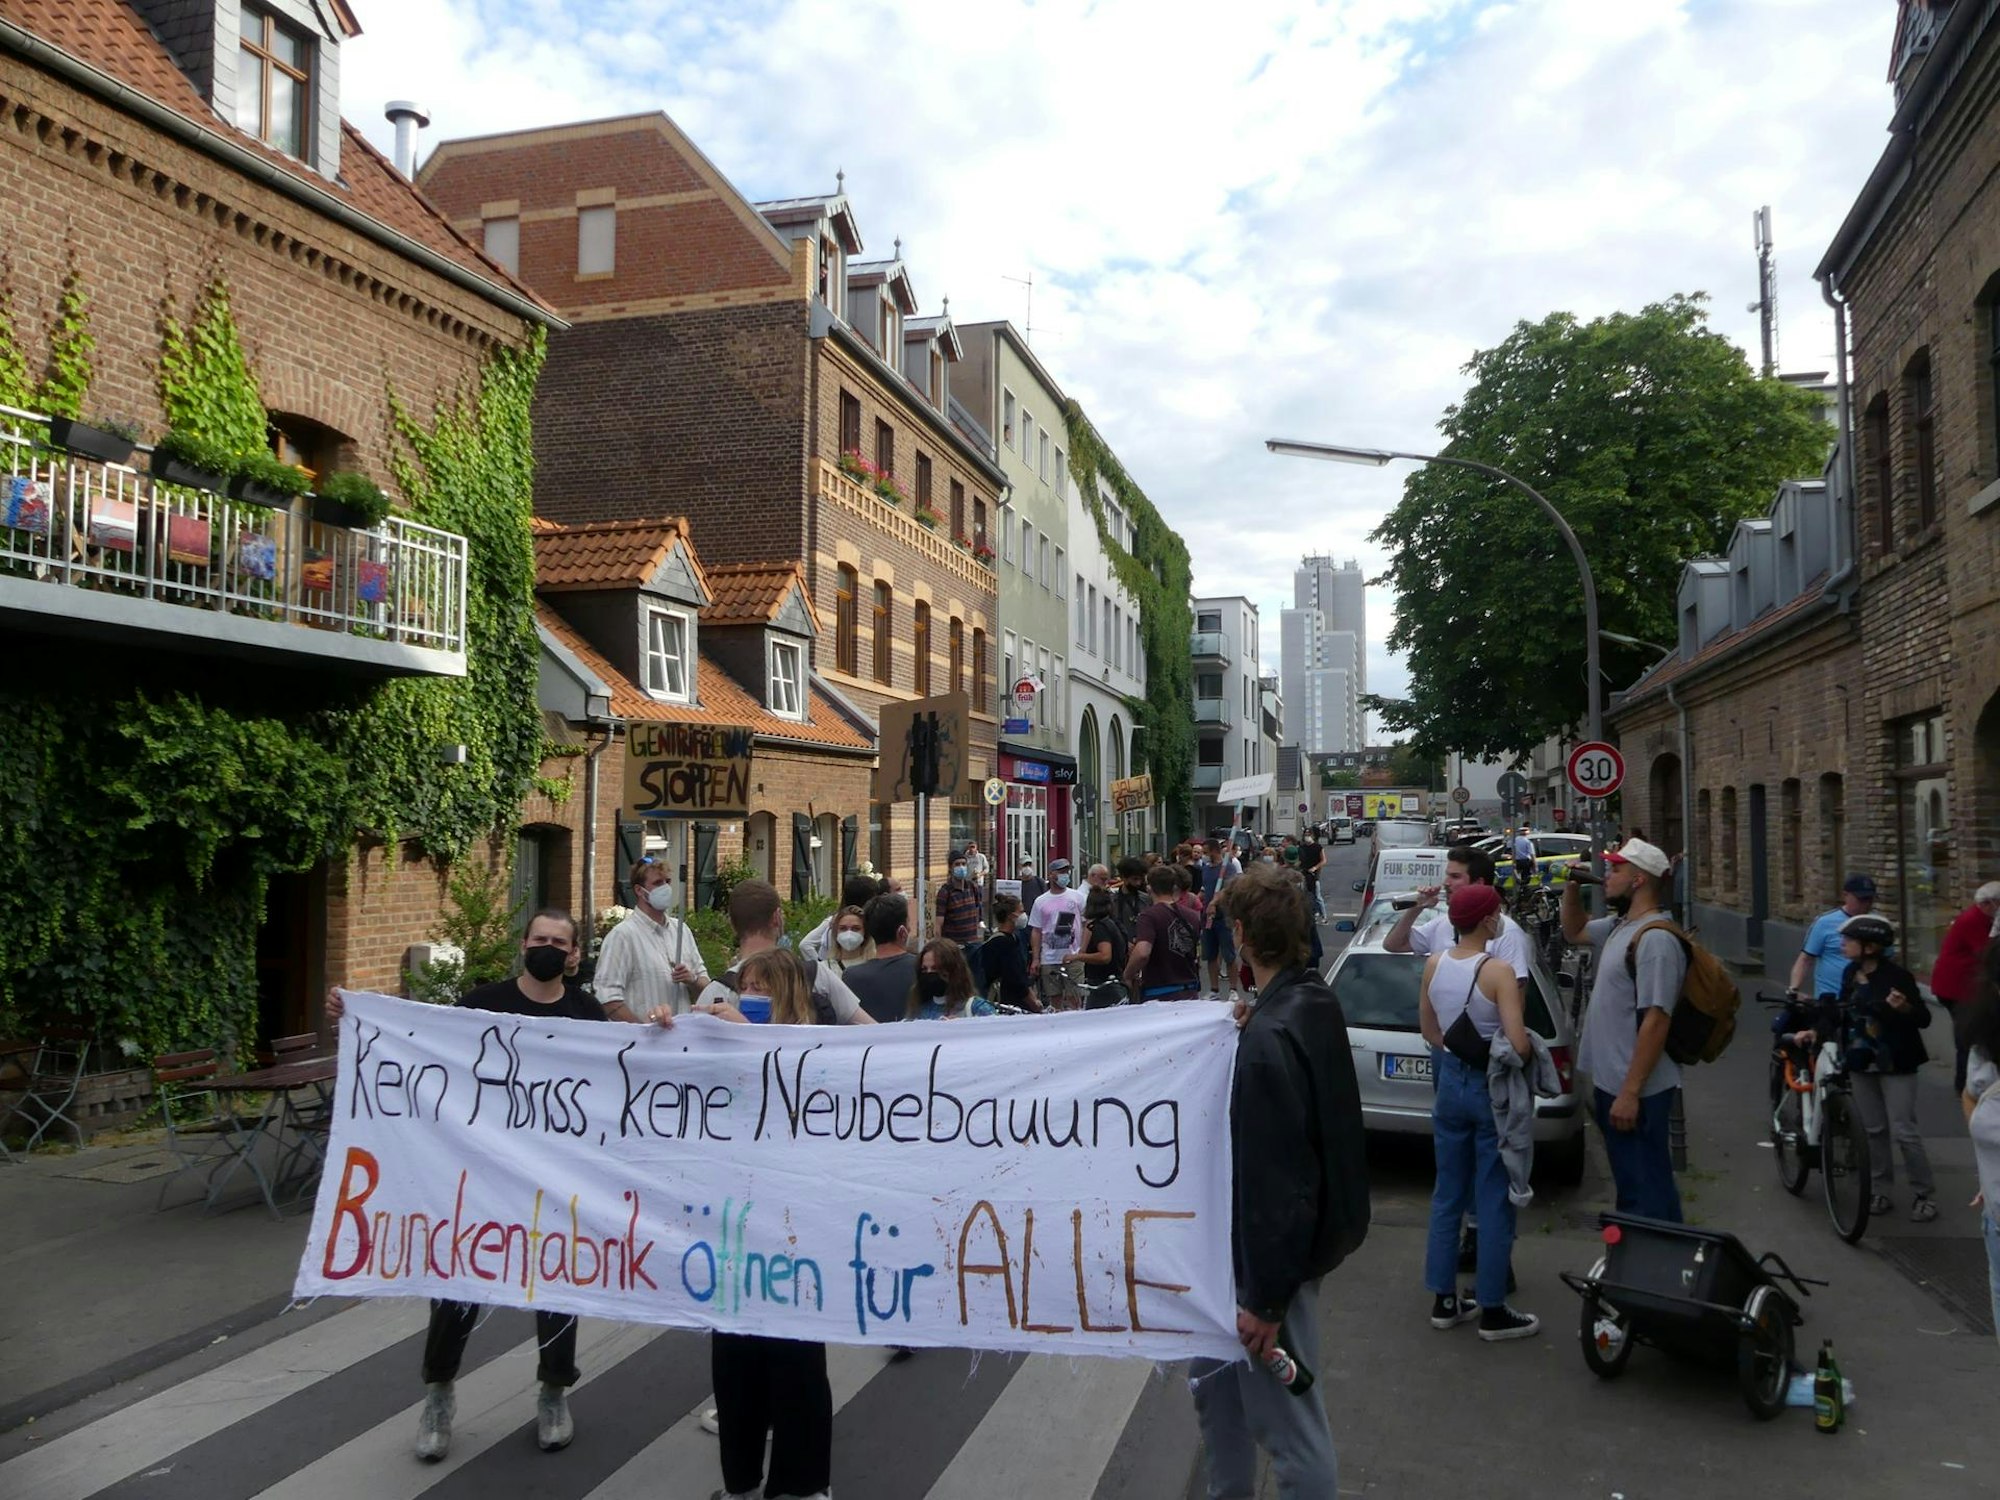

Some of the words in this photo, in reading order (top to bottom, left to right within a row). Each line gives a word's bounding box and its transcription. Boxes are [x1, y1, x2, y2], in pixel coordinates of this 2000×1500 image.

[633, 760, 750, 810] STOPPEN
[1054, 768, 1075, 780] sky
[1580, 757, 1612, 781] 30
[1395, 1058, 1405, 1073] K
[351, 1016, 448, 1122] Kein
[754, 1043, 1180, 1188] Neubebauung
[322, 1147, 658, 1302] Brunckenfabrik
[682, 1196, 823, 1315] öffnen
[848, 1211, 935, 1335] für
[956, 1200, 1196, 1334] ALLE
